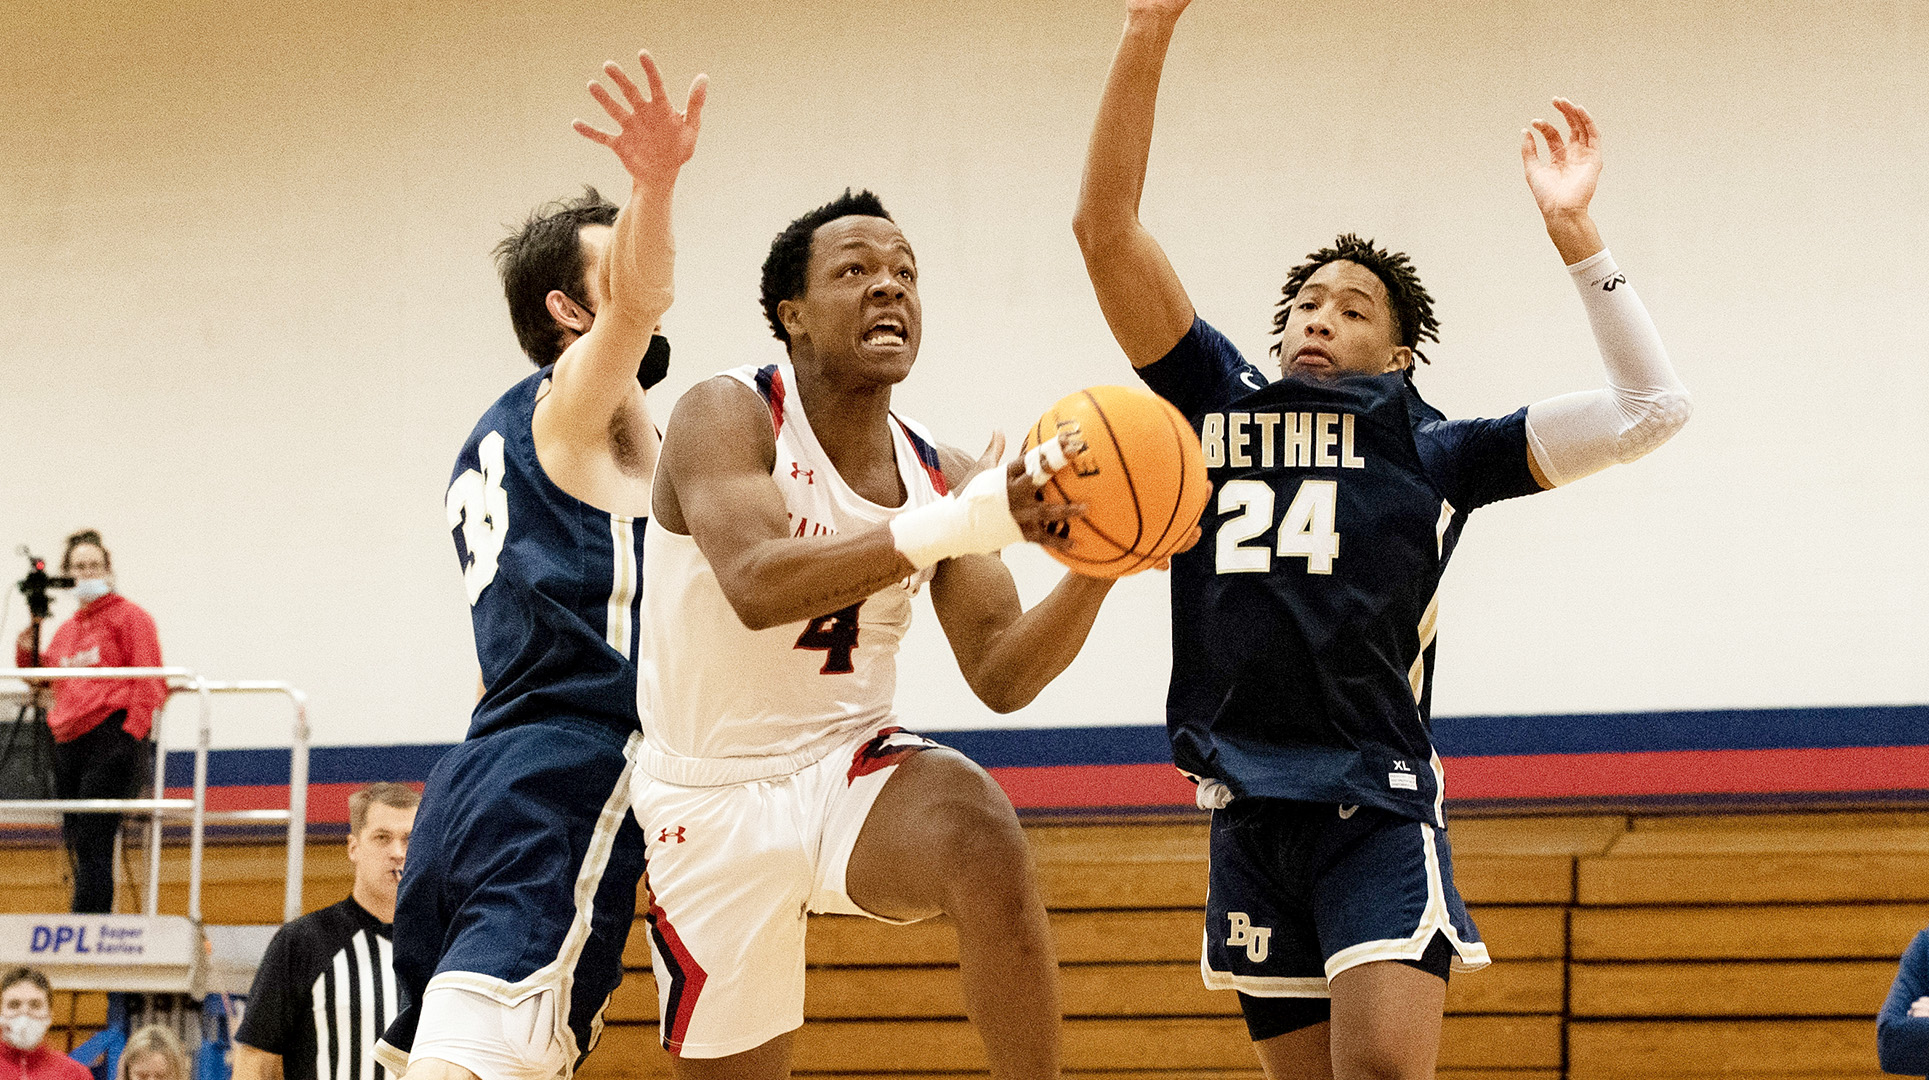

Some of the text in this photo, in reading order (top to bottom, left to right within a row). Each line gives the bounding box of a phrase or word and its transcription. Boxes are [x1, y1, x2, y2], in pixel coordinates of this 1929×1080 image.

[1202, 412, 1366, 469] BETHEL
[1215, 480, 1340, 575] 24
[793, 598, 867, 675] 4
[1393, 760, 1411, 771] XL
[30, 925, 90, 953] DPL
[1226, 911, 1272, 963] BU
